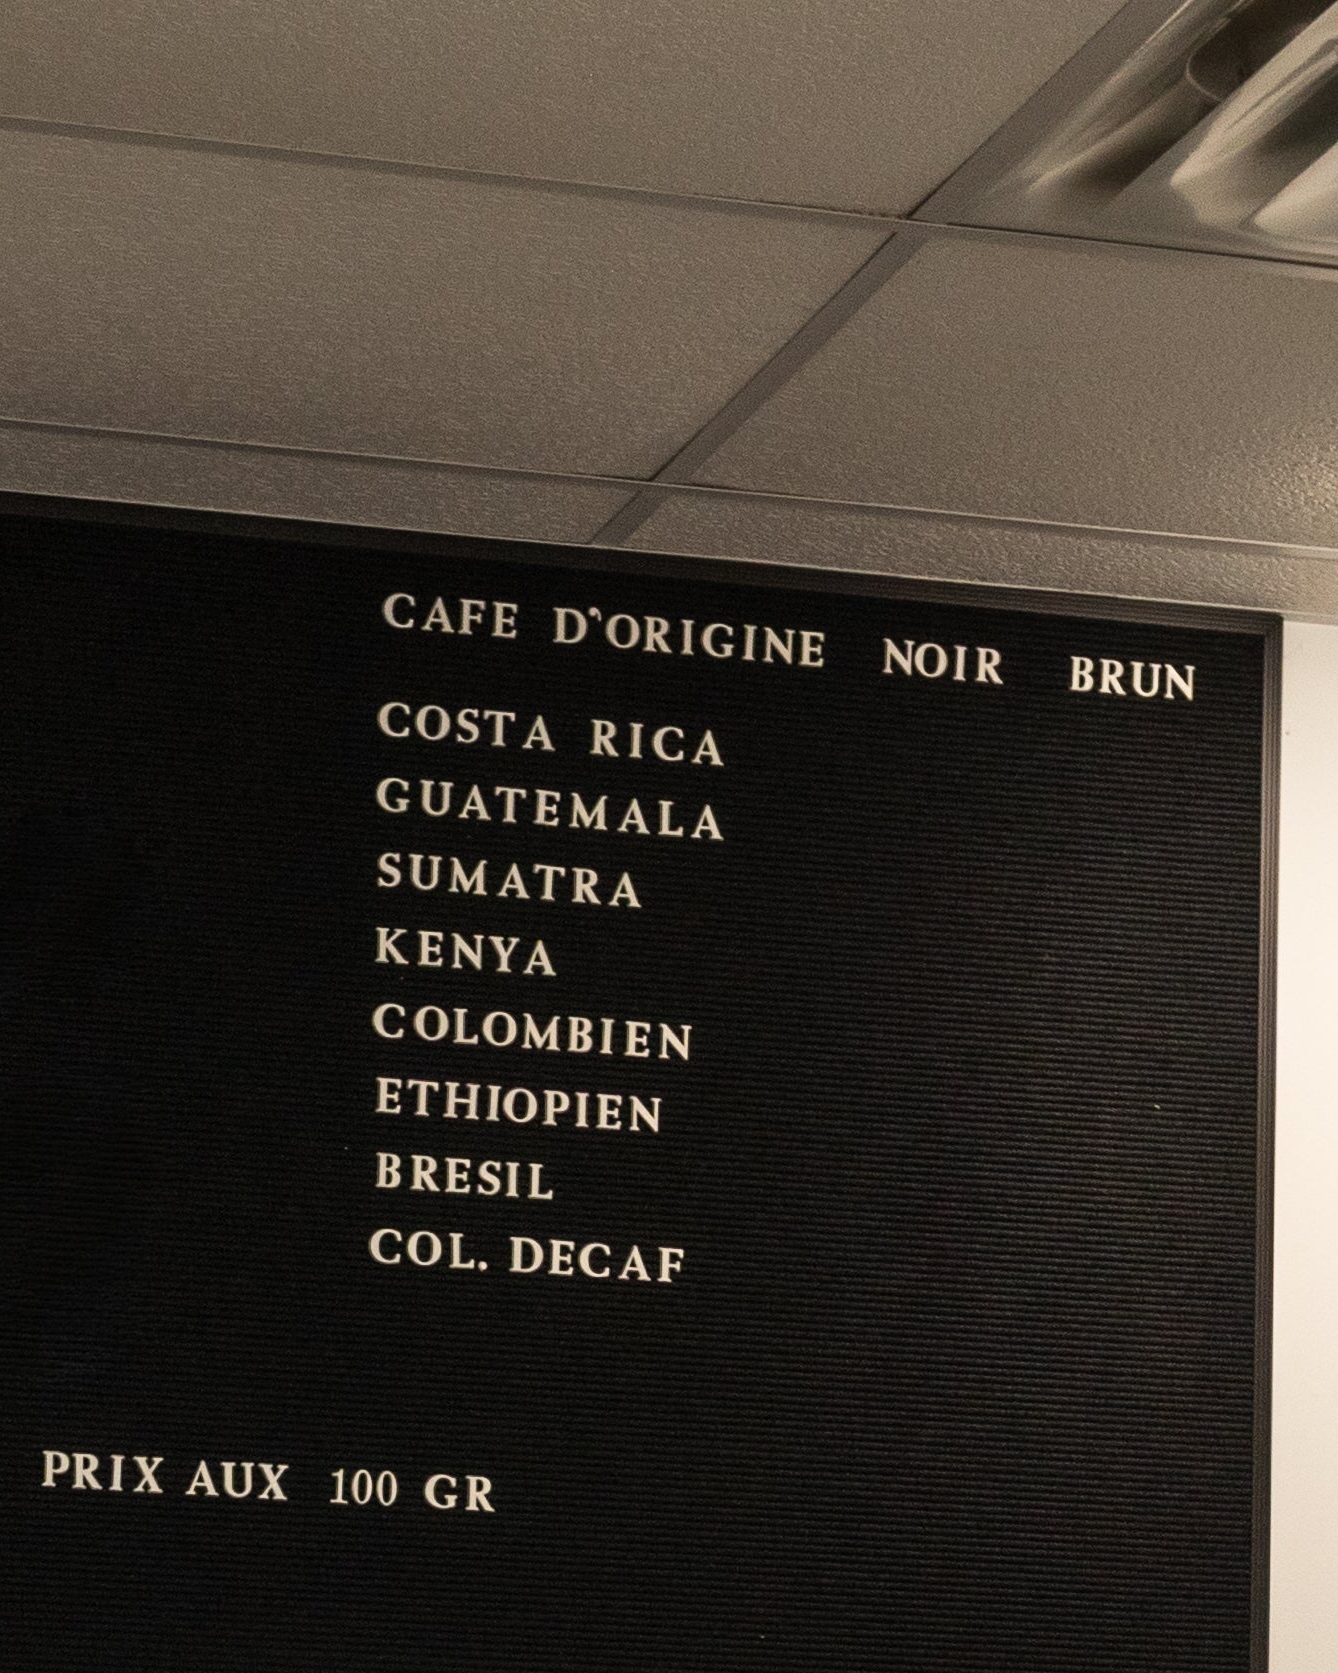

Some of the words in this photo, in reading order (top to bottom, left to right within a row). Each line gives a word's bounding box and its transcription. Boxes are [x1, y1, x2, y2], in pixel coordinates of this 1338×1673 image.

[382, 592, 518, 639] CAFE
[882, 636, 1004, 685] NOIR
[1068, 654, 1196, 701] BRUN
[376, 700, 555, 751] COSTA
[589, 718, 725, 767] RICA
[375, 776, 724, 841] GUATEMALA
[376, 851, 642, 908] SUMATRA
[374, 925, 557, 977] KENYA
[371, 1001, 693, 1061] COLOMBIEN
[374, 1075, 663, 1133] ETHIOPIEN
[374, 1150, 554, 1200] BRESIL
[367, 1227, 488, 1272] COL.
[508, 1235, 685, 1283] DECAF
[40, 1449, 164, 1494] PRIX
[184, 1458, 289, 1501] AUX
[328, 1467, 398, 1507] 100
[423, 1472, 496, 1513] GR
